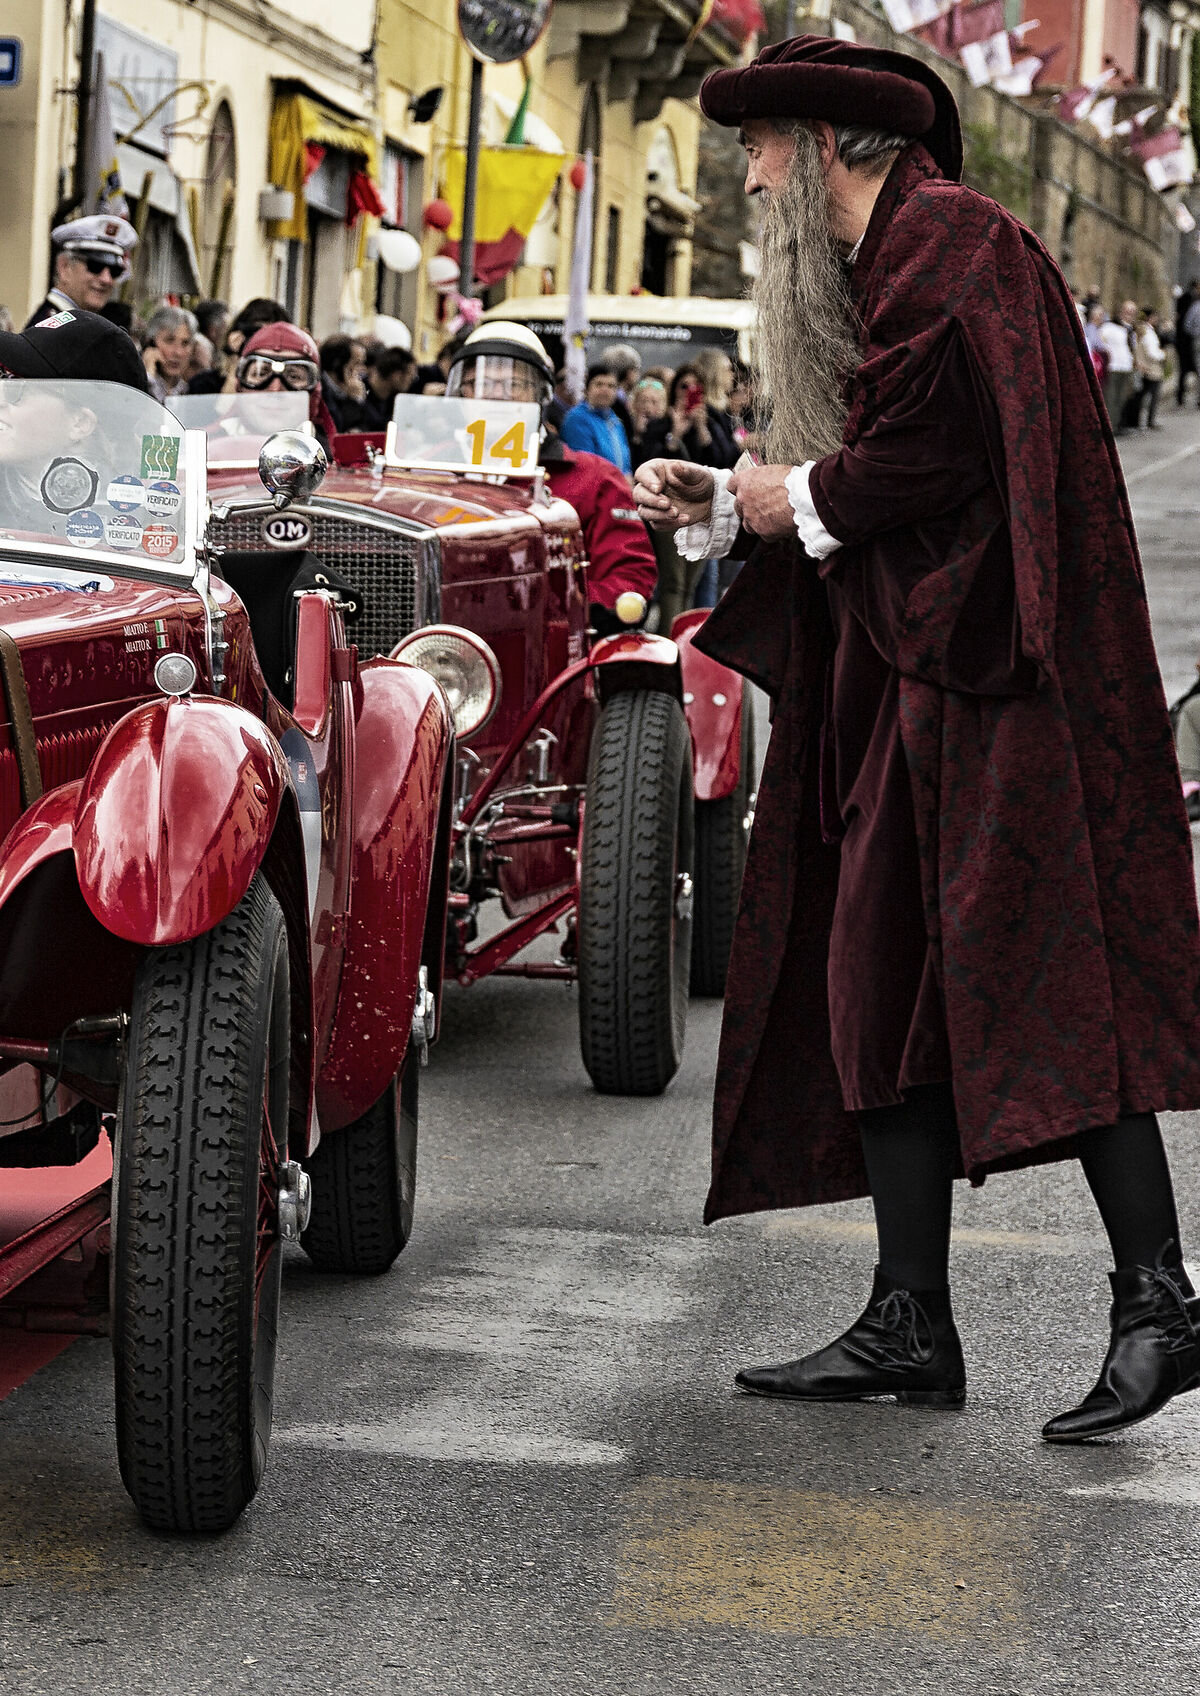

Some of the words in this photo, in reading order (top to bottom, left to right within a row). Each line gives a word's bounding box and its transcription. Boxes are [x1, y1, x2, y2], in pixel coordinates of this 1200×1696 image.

[621, 322, 692, 342] Leonardo
[467, 419, 529, 468] 14
[146, 493, 179, 507] VERIFICATO
[108, 529, 141, 541] VERIFICATO
[270, 520, 305, 539] OM
[147, 535, 173, 547] 2015
[123, 622, 143, 637] MIATTO
[125, 639, 145, 653] MIATTO
